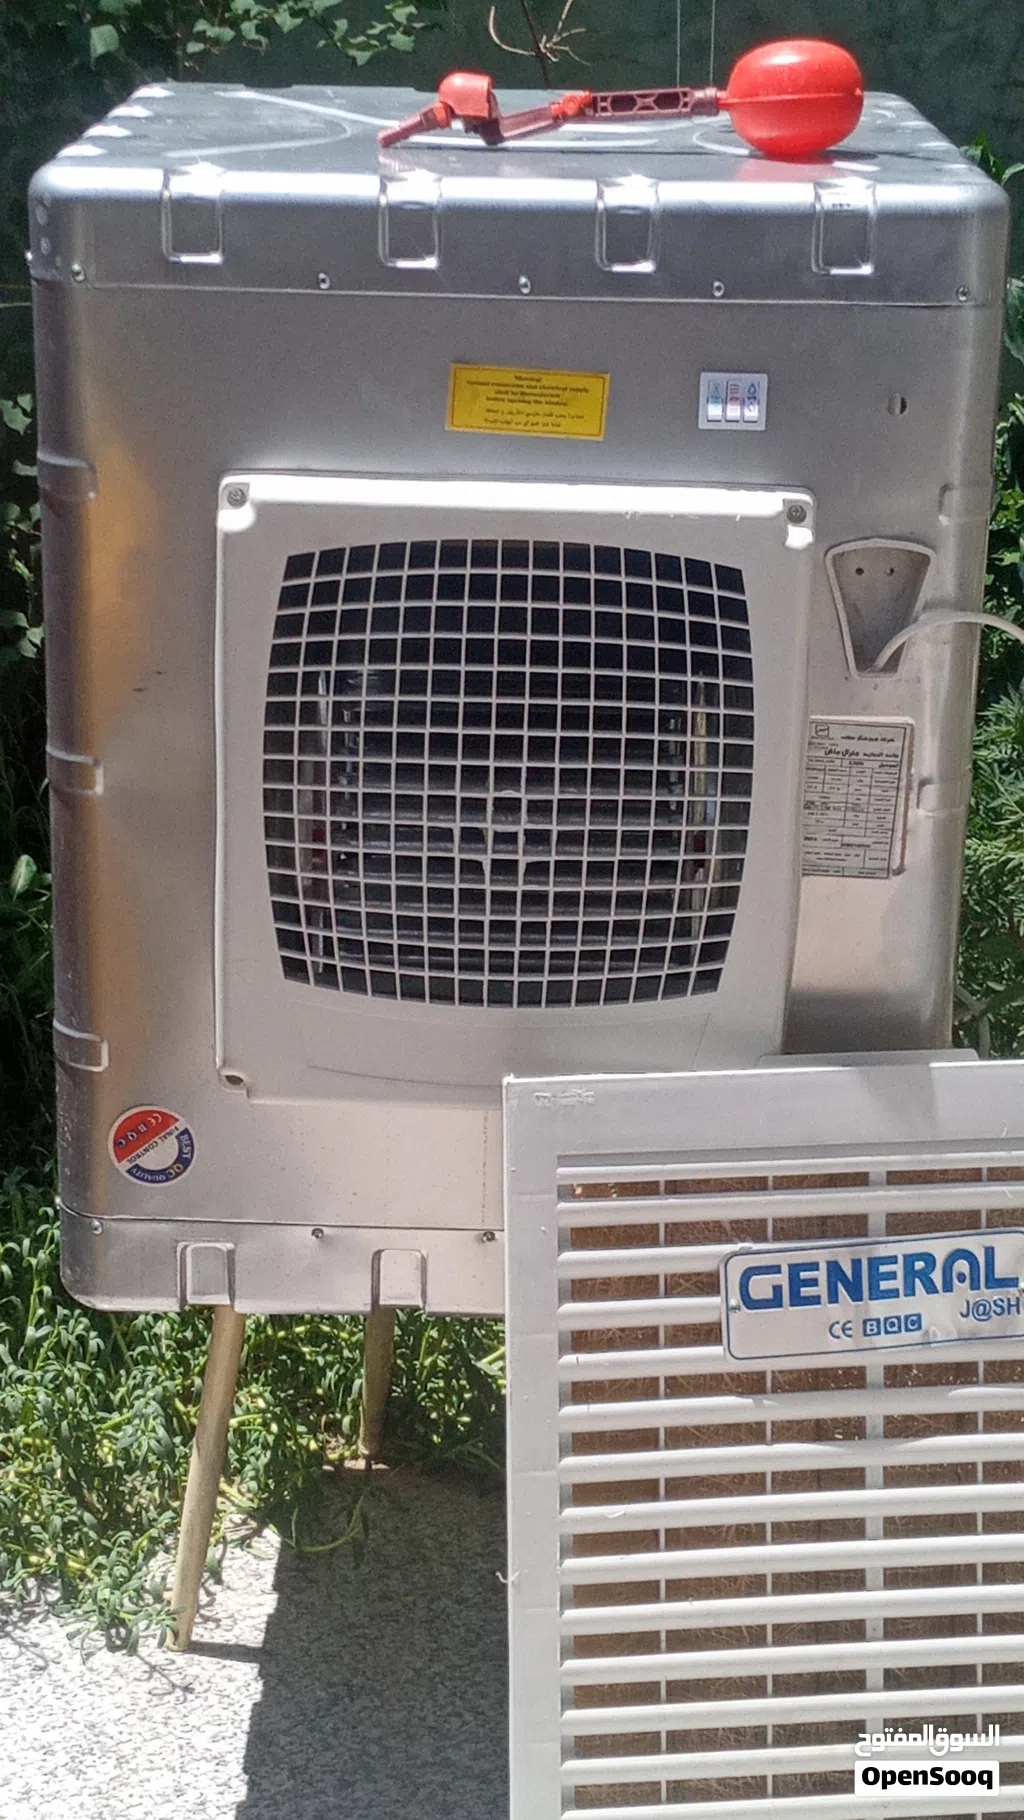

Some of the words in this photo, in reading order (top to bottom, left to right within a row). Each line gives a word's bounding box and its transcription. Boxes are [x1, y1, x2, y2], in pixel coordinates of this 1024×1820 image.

[158, 1125, 180, 1143] FINAL
[181, 1133, 192, 1159] BEST
[126, 1140, 159, 1164] CONTROL
[739, 1246, 1019, 1311] GENERAL
